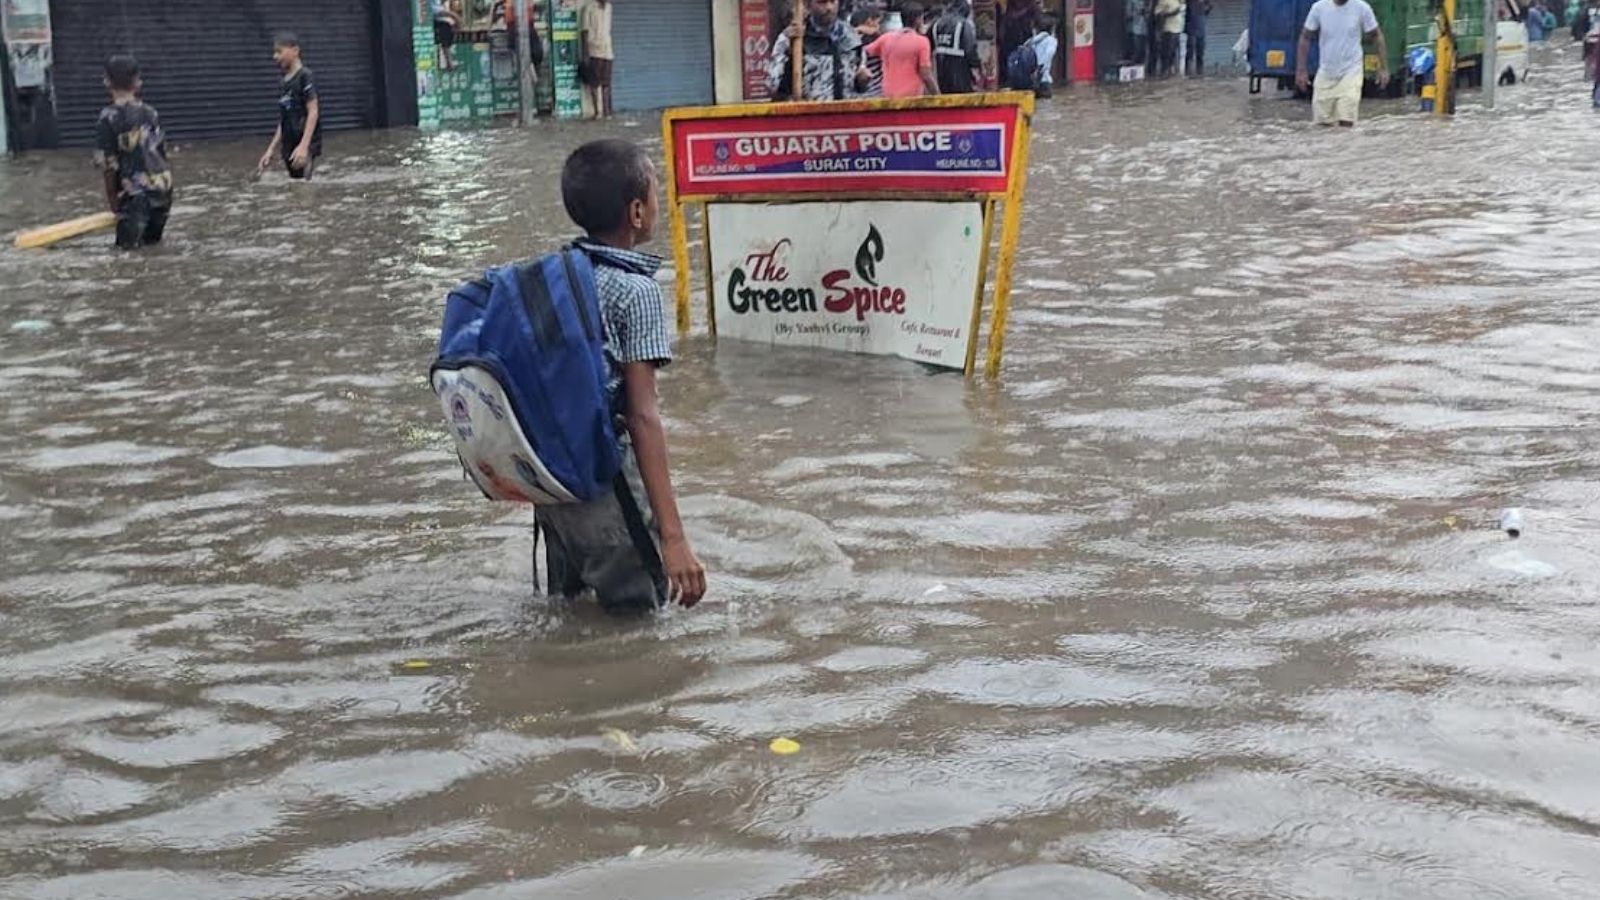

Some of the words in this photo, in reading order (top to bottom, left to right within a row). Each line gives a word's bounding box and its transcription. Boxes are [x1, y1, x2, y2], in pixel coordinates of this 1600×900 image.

[735, 135, 850, 156] GUJARAT
[857, 130, 952, 152] POLICE
[803, 157, 852, 172] SURAT
[854, 156, 888, 170] CITY
[745, 238, 791, 282] The
[727, 267, 818, 314] Green
[821, 268, 906, 321] Spice
[832, 322, 870, 337] Group)
